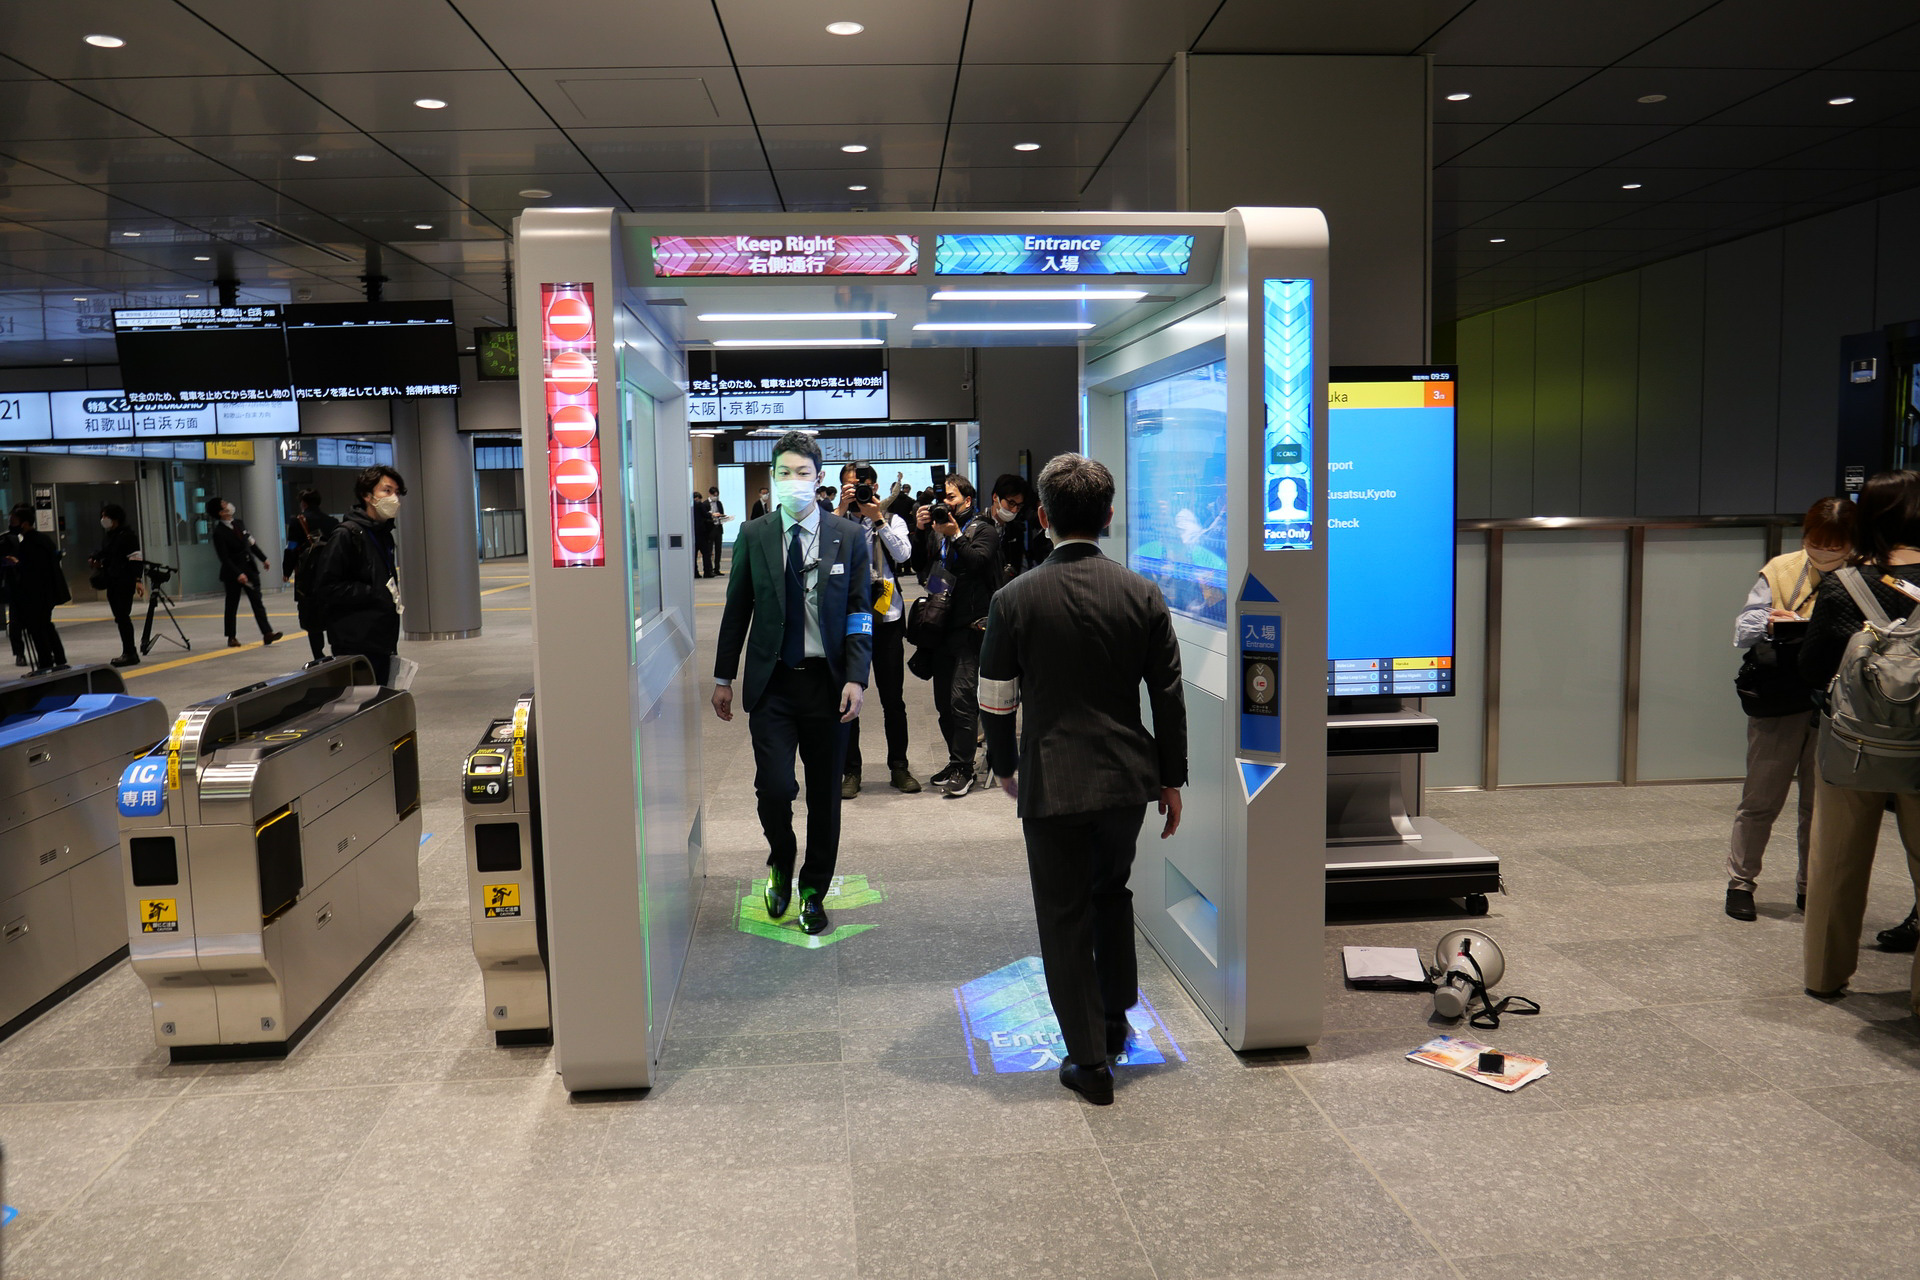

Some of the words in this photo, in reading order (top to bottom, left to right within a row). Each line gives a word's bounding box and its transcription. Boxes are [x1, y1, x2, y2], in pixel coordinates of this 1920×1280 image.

[737, 237, 783, 254] Keep
[785, 236, 835, 254] Right
[1024, 236, 1102, 251] Entrance
[748, 256, 826, 274] 右側通行
[1041, 256, 1080, 272] 入場
[689, 401, 759, 416] 大阪・京都
[761, 402, 784, 414] 方面
[175, 417, 198, 430] 方面
[1328, 518, 1360, 529] Check
[1264, 529, 1287, 539] Face
[1287, 528, 1310, 540] Only
[1245, 624, 1276, 641] 入場
[1246, 640, 1275, 649] Entrance
[129, 764, 158, 784] IC
[121, 790, 157, 808] 専用
[497, 1008, 505, 1017] 4
[165, 1024, 173, 1034] 3
[263, 1020, 271, 1029] 4
